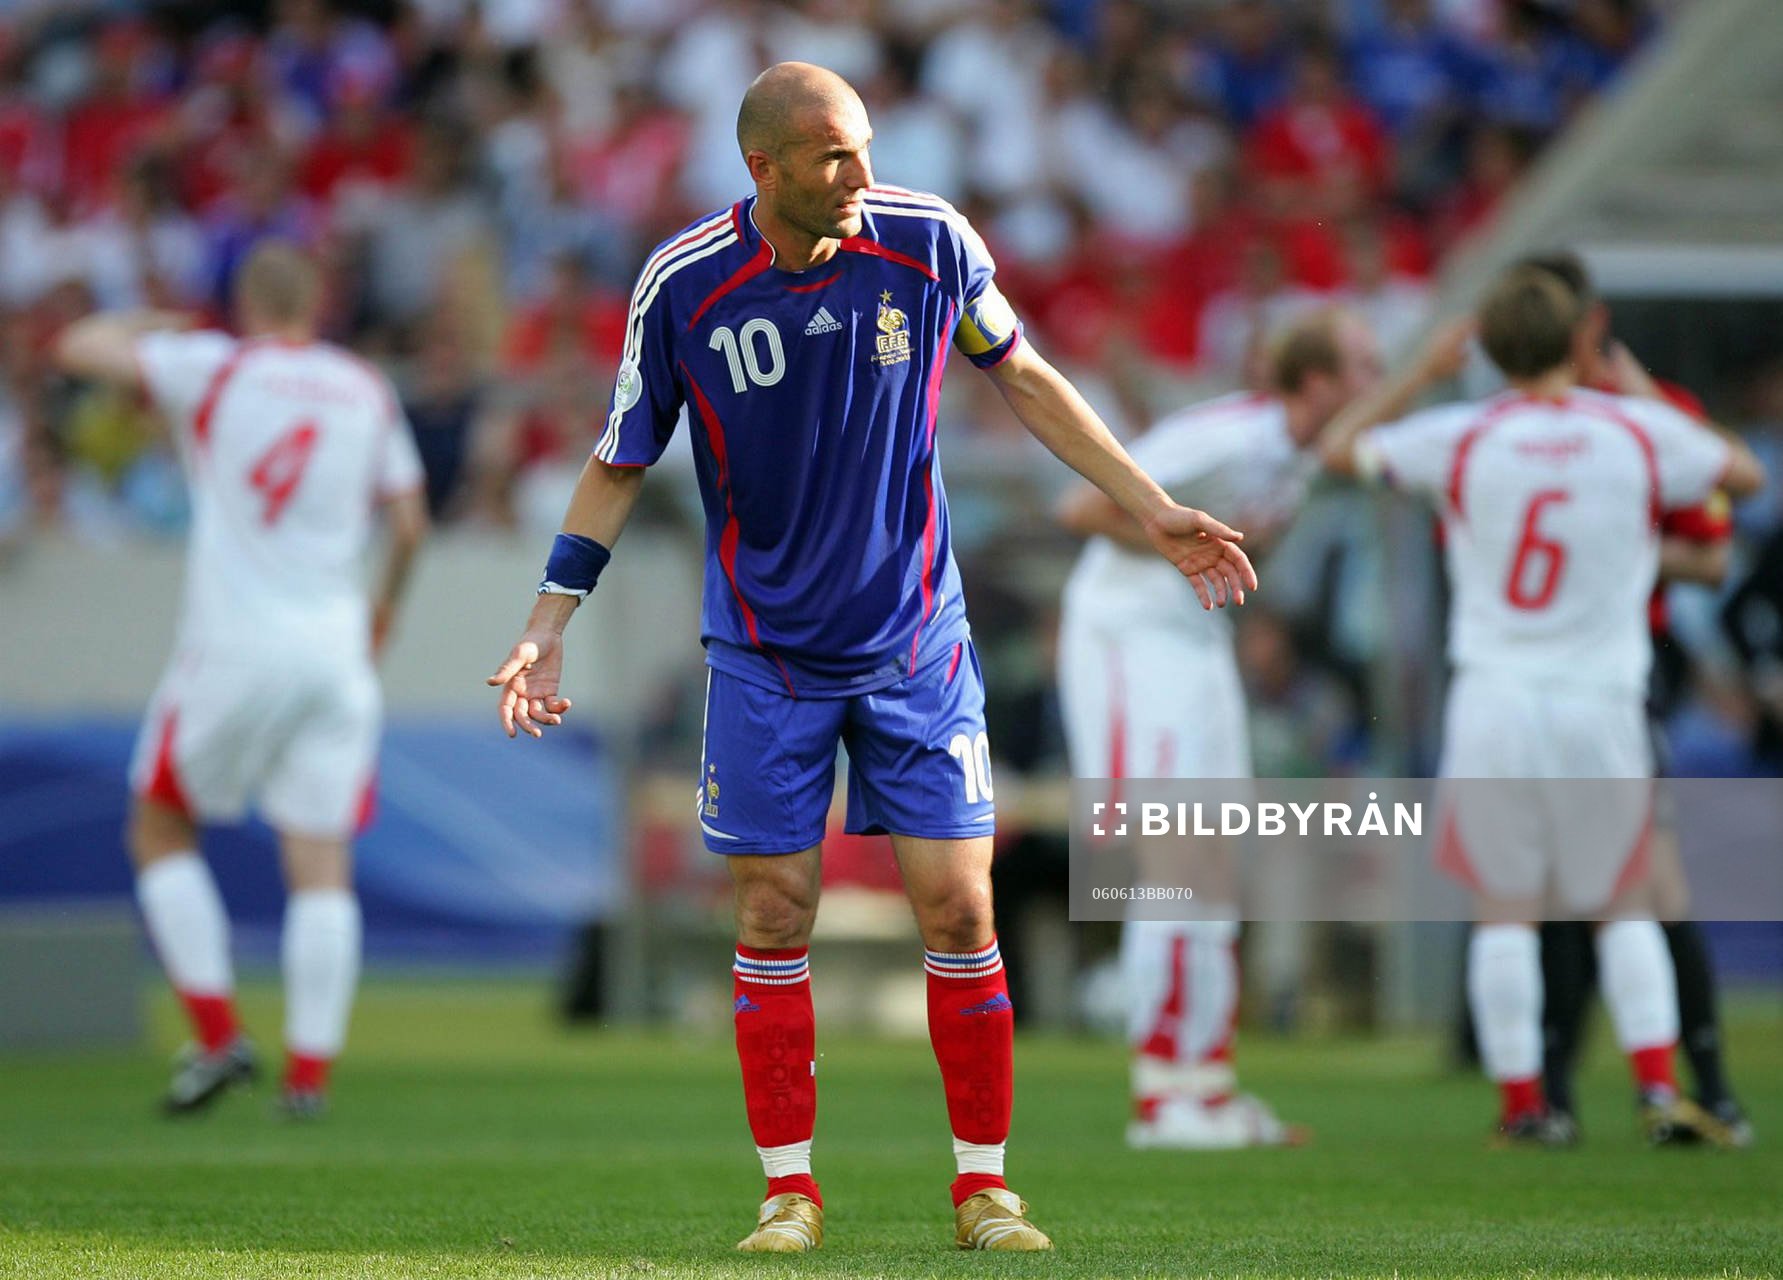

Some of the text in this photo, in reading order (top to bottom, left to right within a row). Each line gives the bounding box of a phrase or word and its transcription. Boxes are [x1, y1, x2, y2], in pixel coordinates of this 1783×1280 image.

[709, 318, 786, 393] 10
[804, 321, 843, 336] adidas
[249, 423, 317, 528] 4
[1506, 488, 1569, 610] 6
[948, 731, 993, 804] 10
